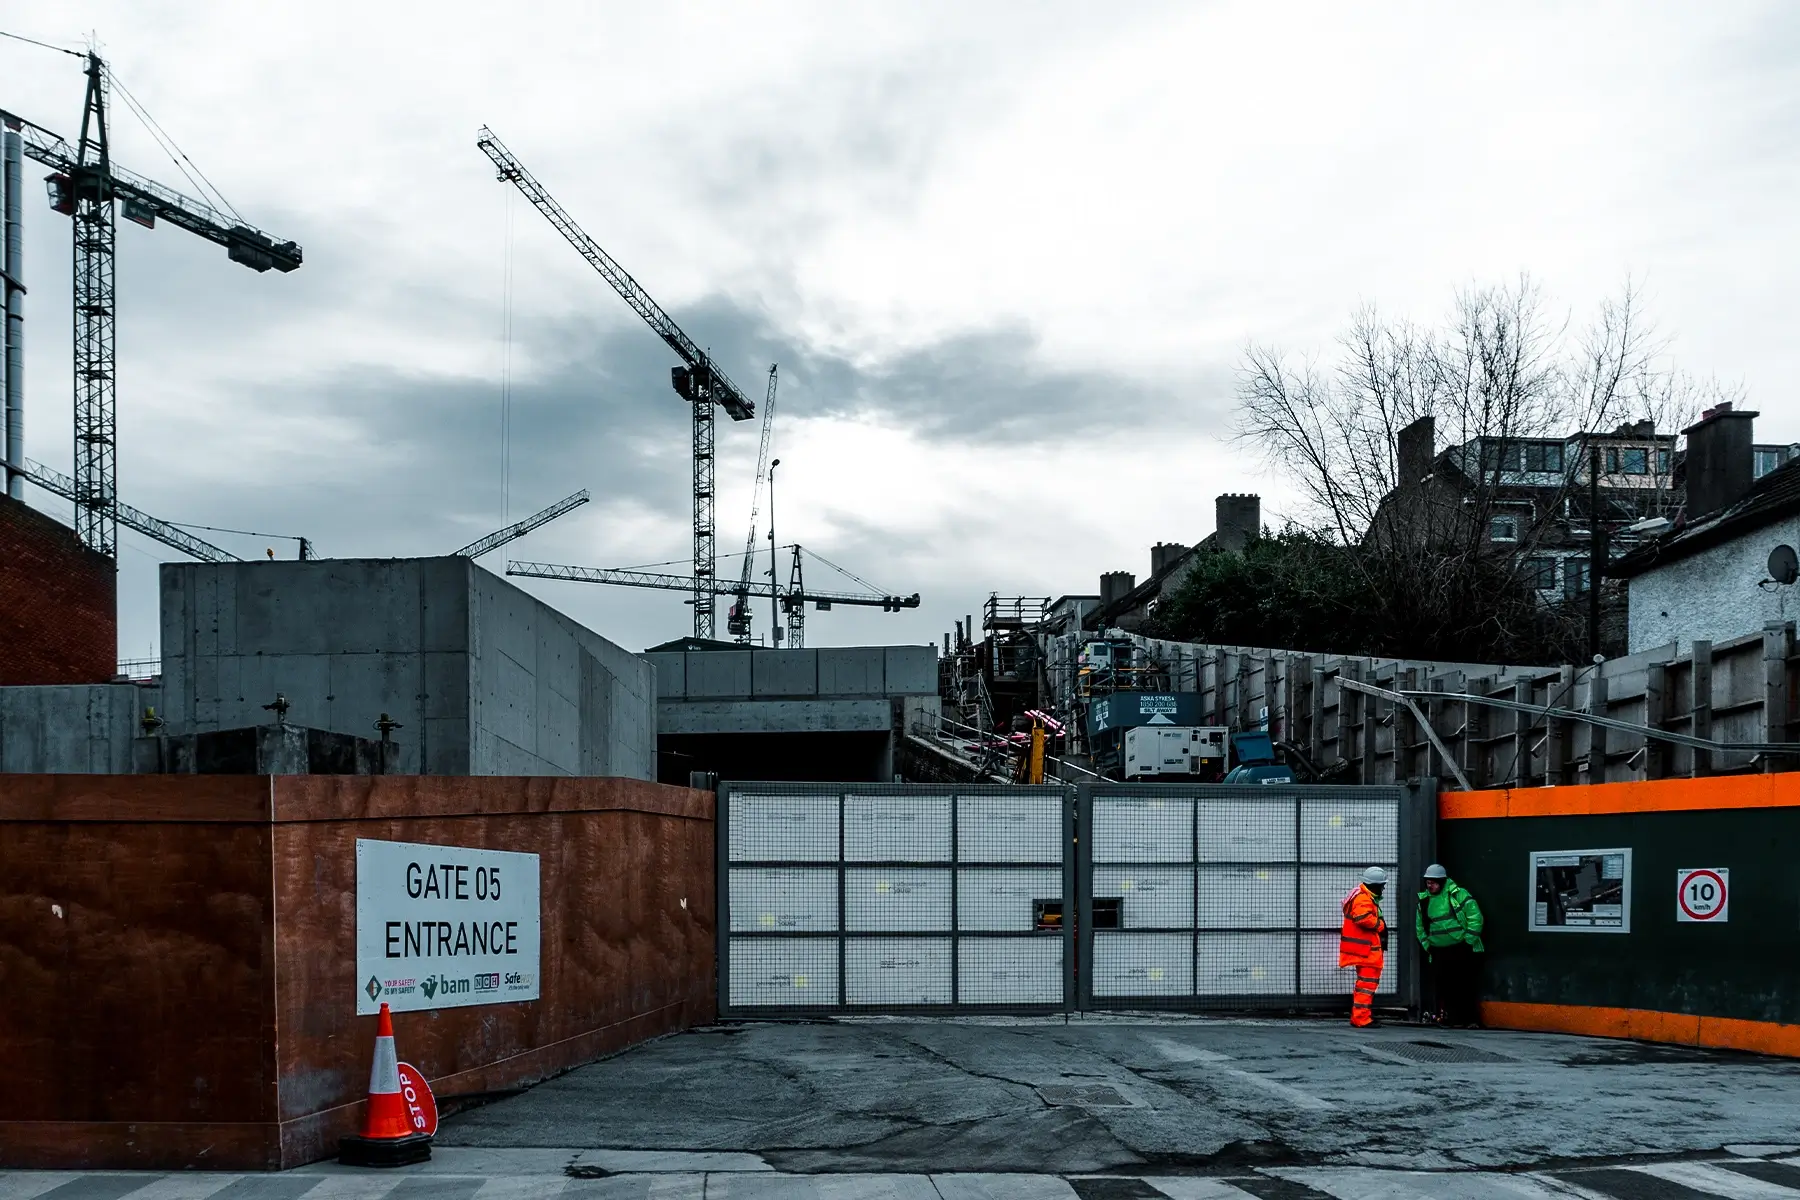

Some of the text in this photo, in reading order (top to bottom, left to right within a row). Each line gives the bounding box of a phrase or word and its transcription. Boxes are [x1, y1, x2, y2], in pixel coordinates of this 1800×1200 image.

[406, 862, 501, 901] GATE 05
[1691, 883, 1714, 901] 10
[386, 921, 518, 958] ENTRANCE
[384, 979, 416, 988] YOUR SAFETY
[384, 986, 416, 995] IS MY SAFETY
[440, 974, 470, 994] bam
[475, 975, 498, 988] NCH
[400, 1073, 425, 1128] STOP
